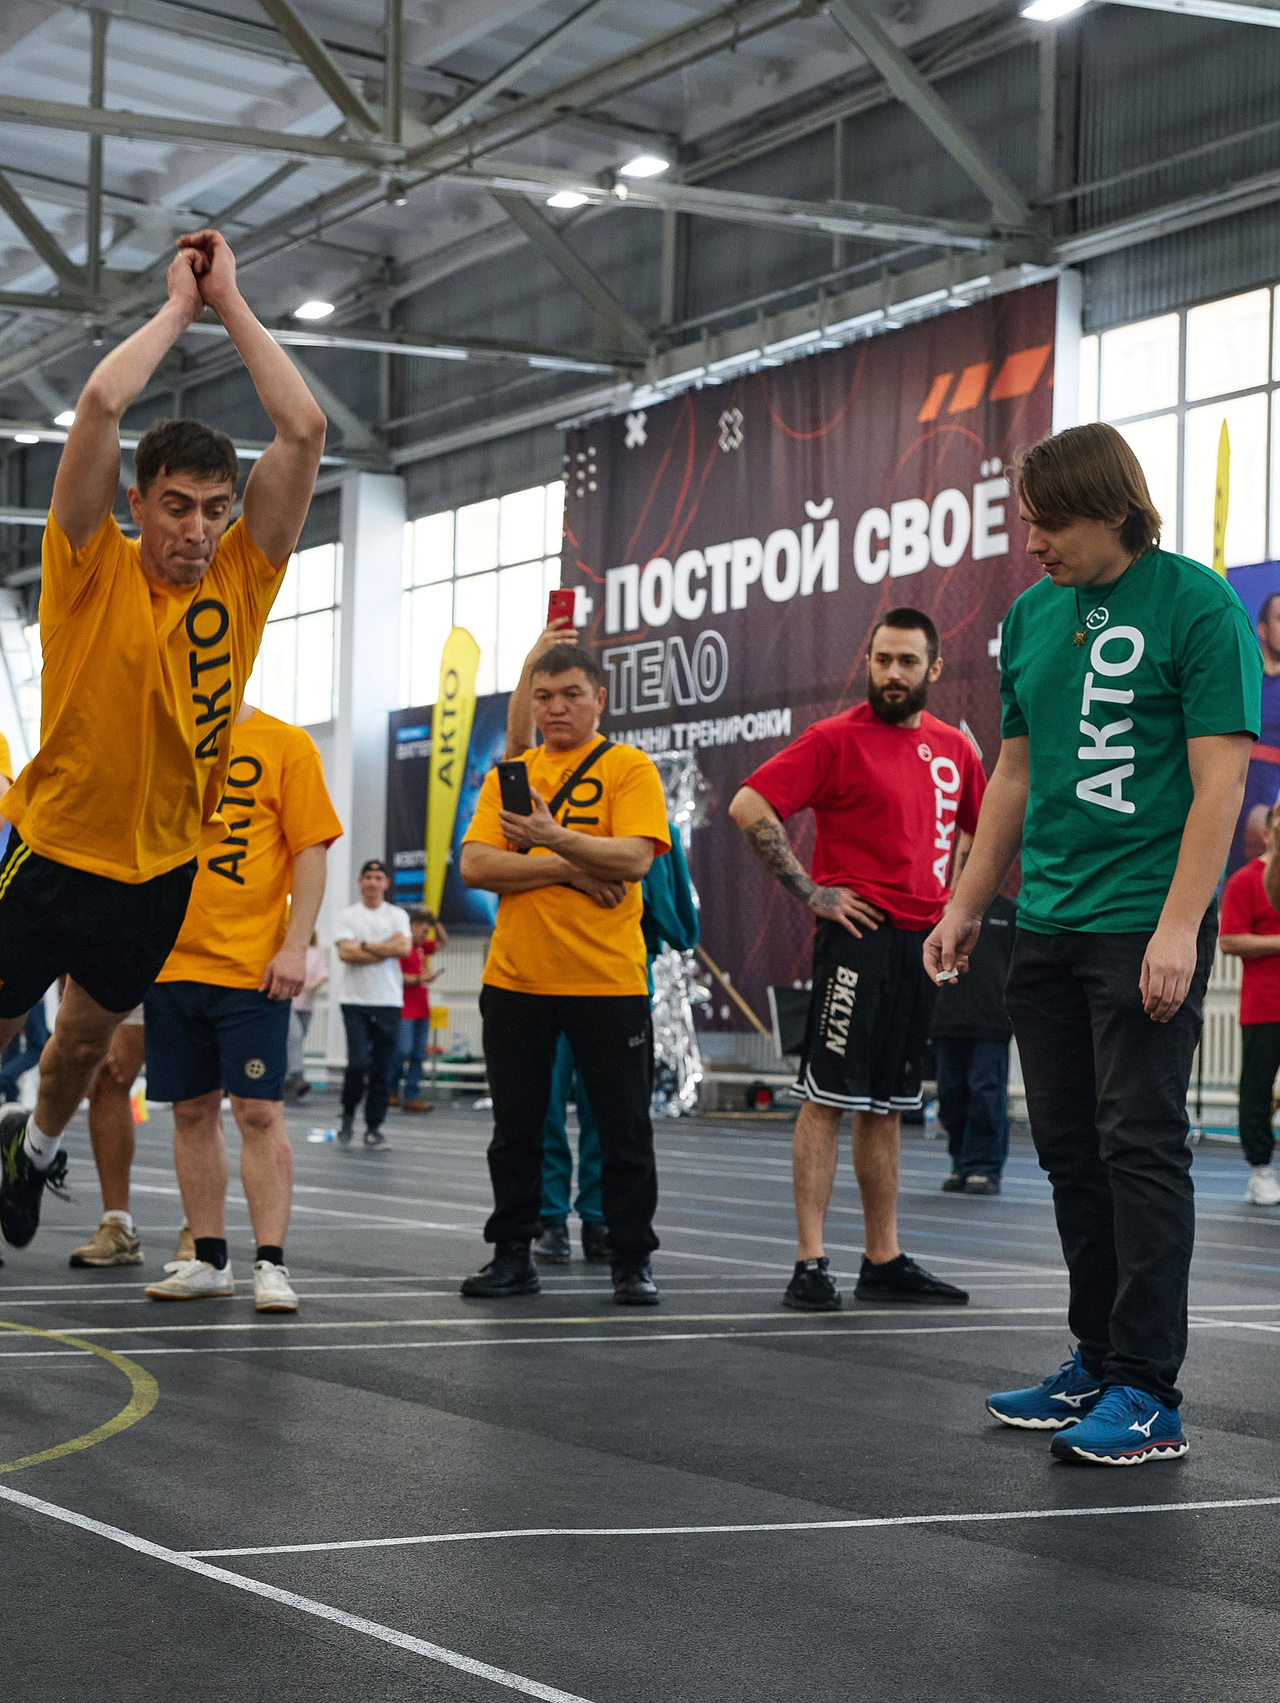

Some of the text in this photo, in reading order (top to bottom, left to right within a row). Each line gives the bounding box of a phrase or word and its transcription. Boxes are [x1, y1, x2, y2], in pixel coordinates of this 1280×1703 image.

[605, 456, 1011, 634] ПОСТРОЙ СВОЁ
[186, 599, 231, 759] АКТО
[438, 667, 459, 787] АКТО
[603, 630, 729, 716] ТЕЛО
[671, 707, 792, 749] ТРЕНИРОВКИ
[1076, 625, 1145, 814] АКТО
[932, 756, 961, 888] АКТО
[825, 965, 859, 1057] BKLYN
